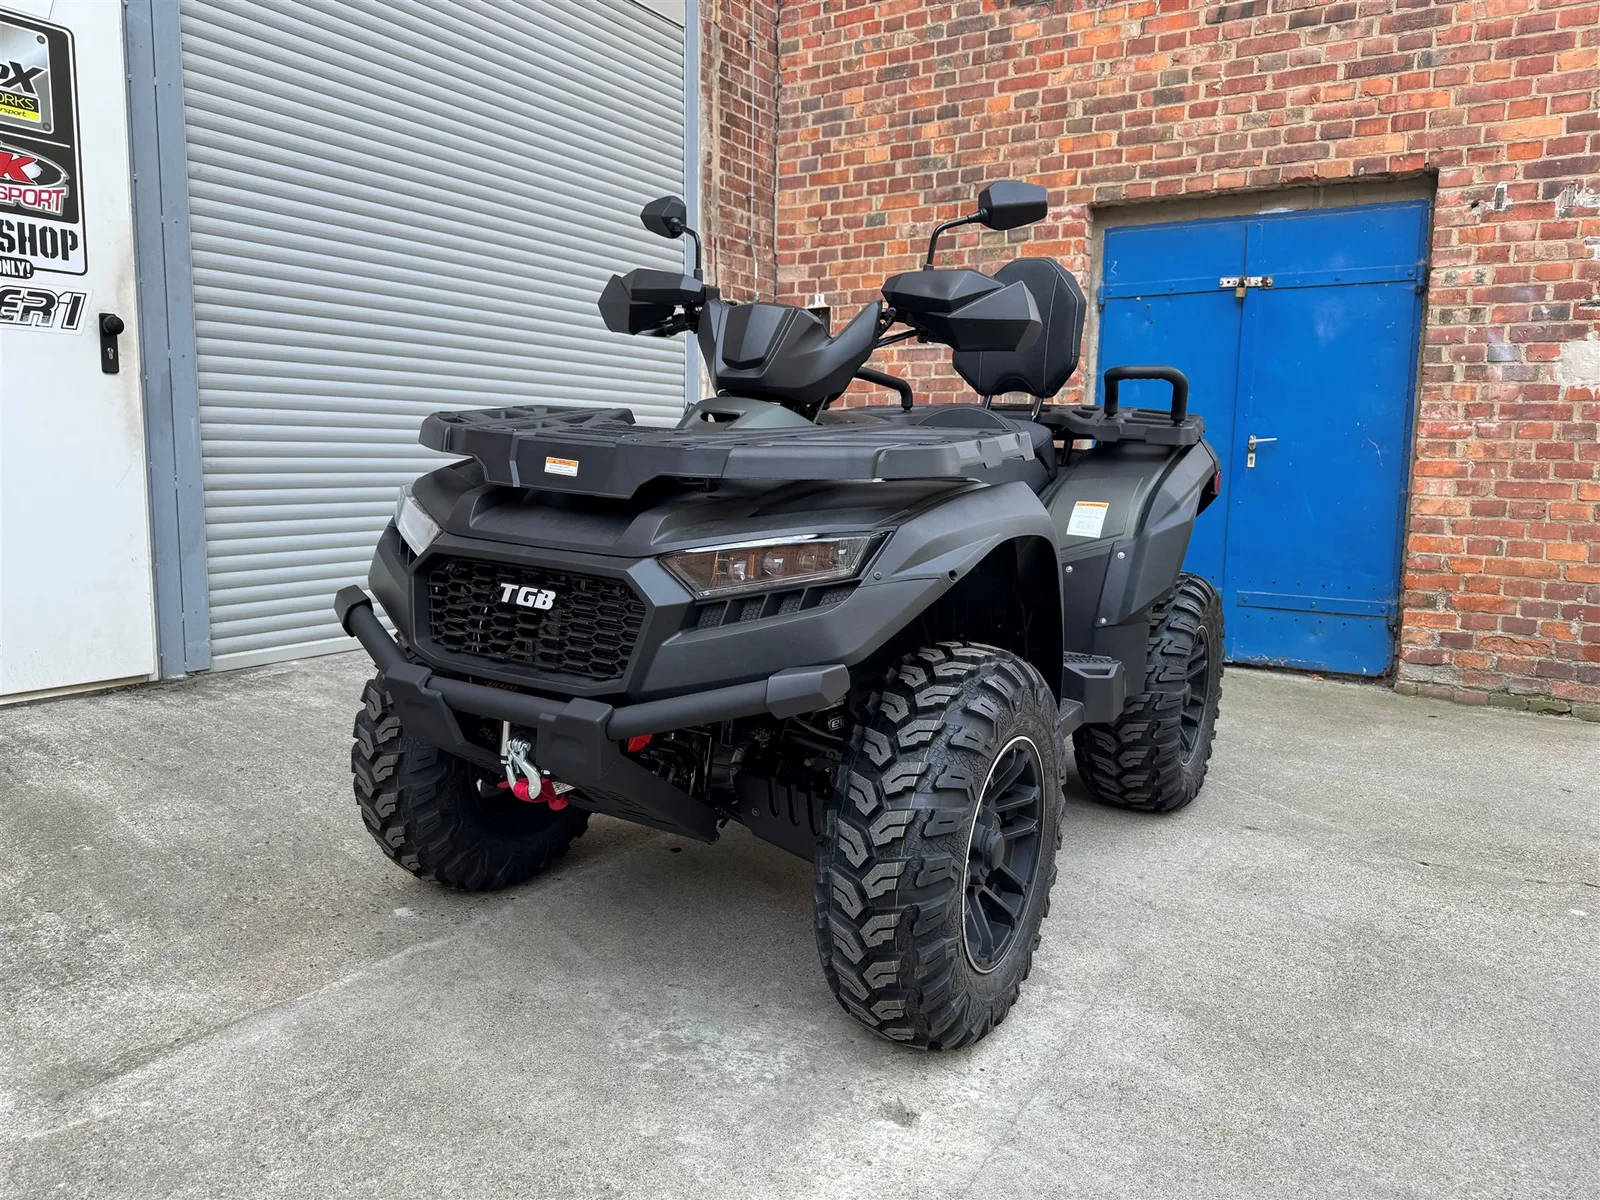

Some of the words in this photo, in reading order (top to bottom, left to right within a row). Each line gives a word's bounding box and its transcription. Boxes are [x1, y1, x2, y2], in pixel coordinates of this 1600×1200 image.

[0, 218, 79, 261] SHOP
[0, 258, 31, 278] NLY!
[500, 582, 556, 610] TGB
